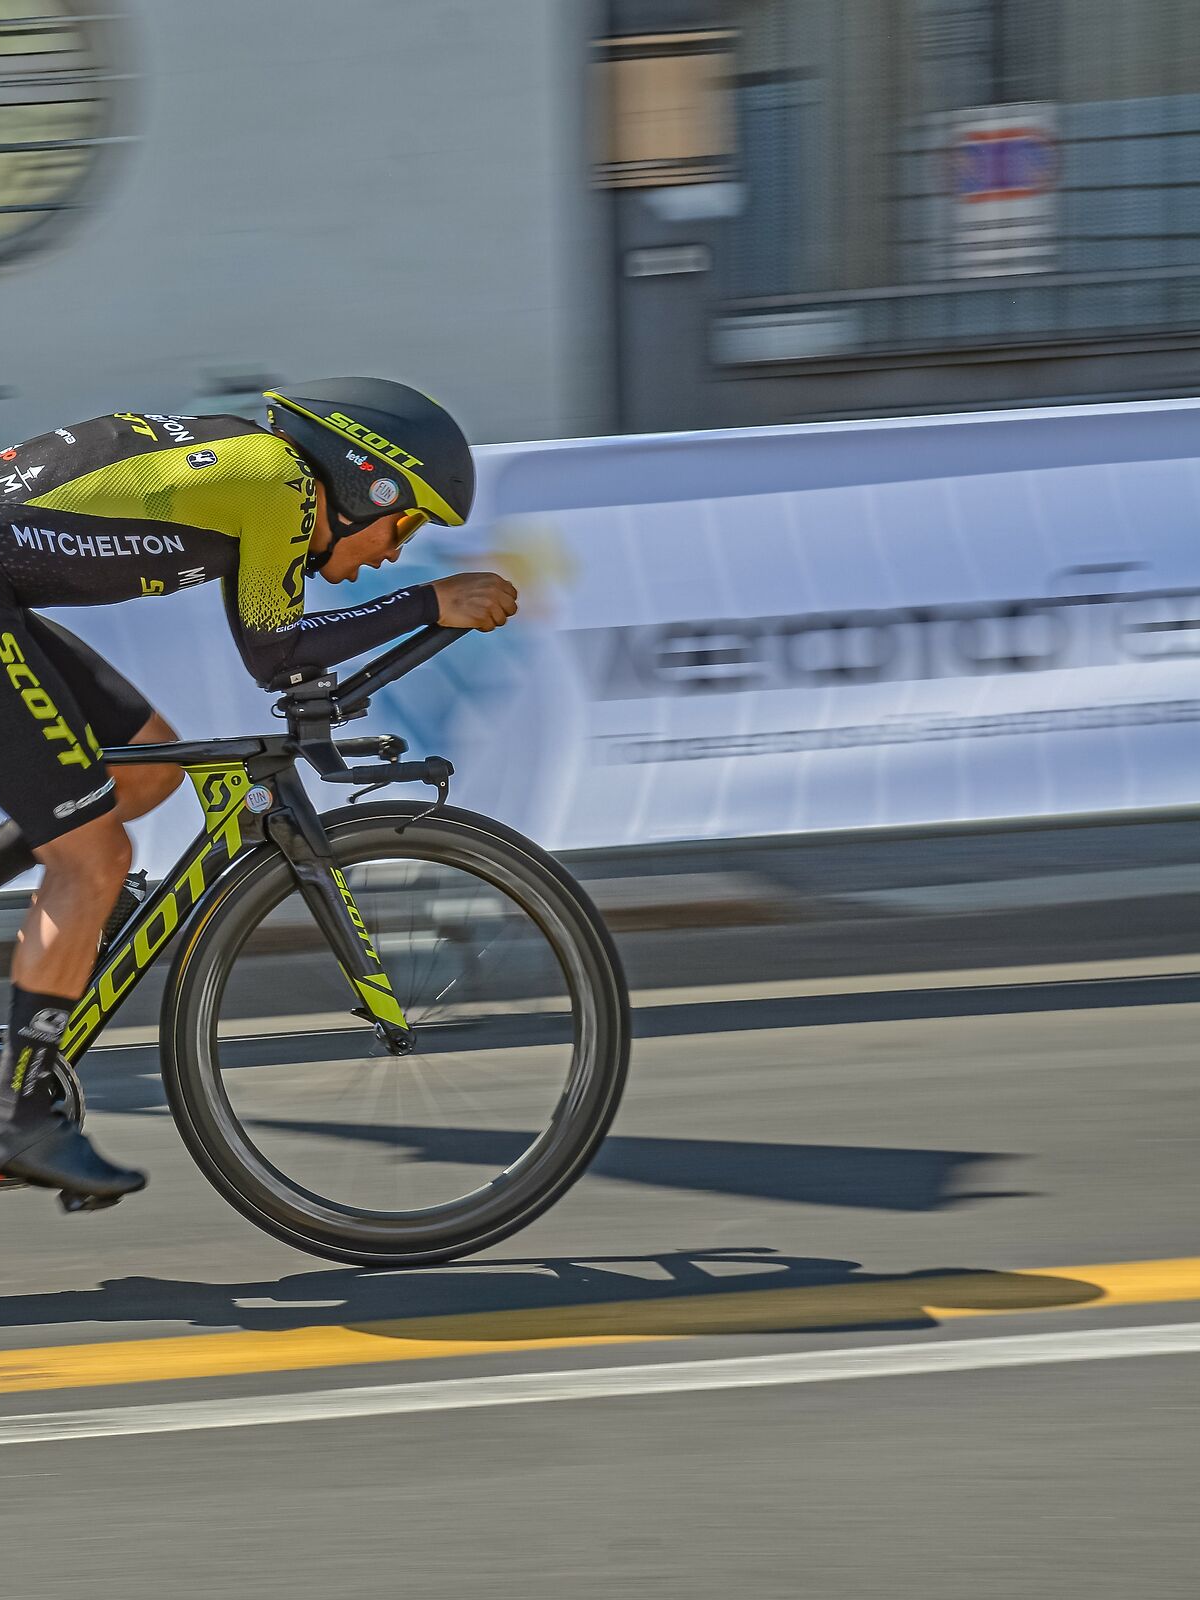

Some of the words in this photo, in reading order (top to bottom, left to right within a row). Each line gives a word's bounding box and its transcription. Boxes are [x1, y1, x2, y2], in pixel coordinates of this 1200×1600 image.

[324, 412, 425, 469] SCOTT
[10, 523, 185, 558] MITCHELTON
[58, 798, 246, 1062] SCOTT
[330, 865, 382, 965] SCOTT
